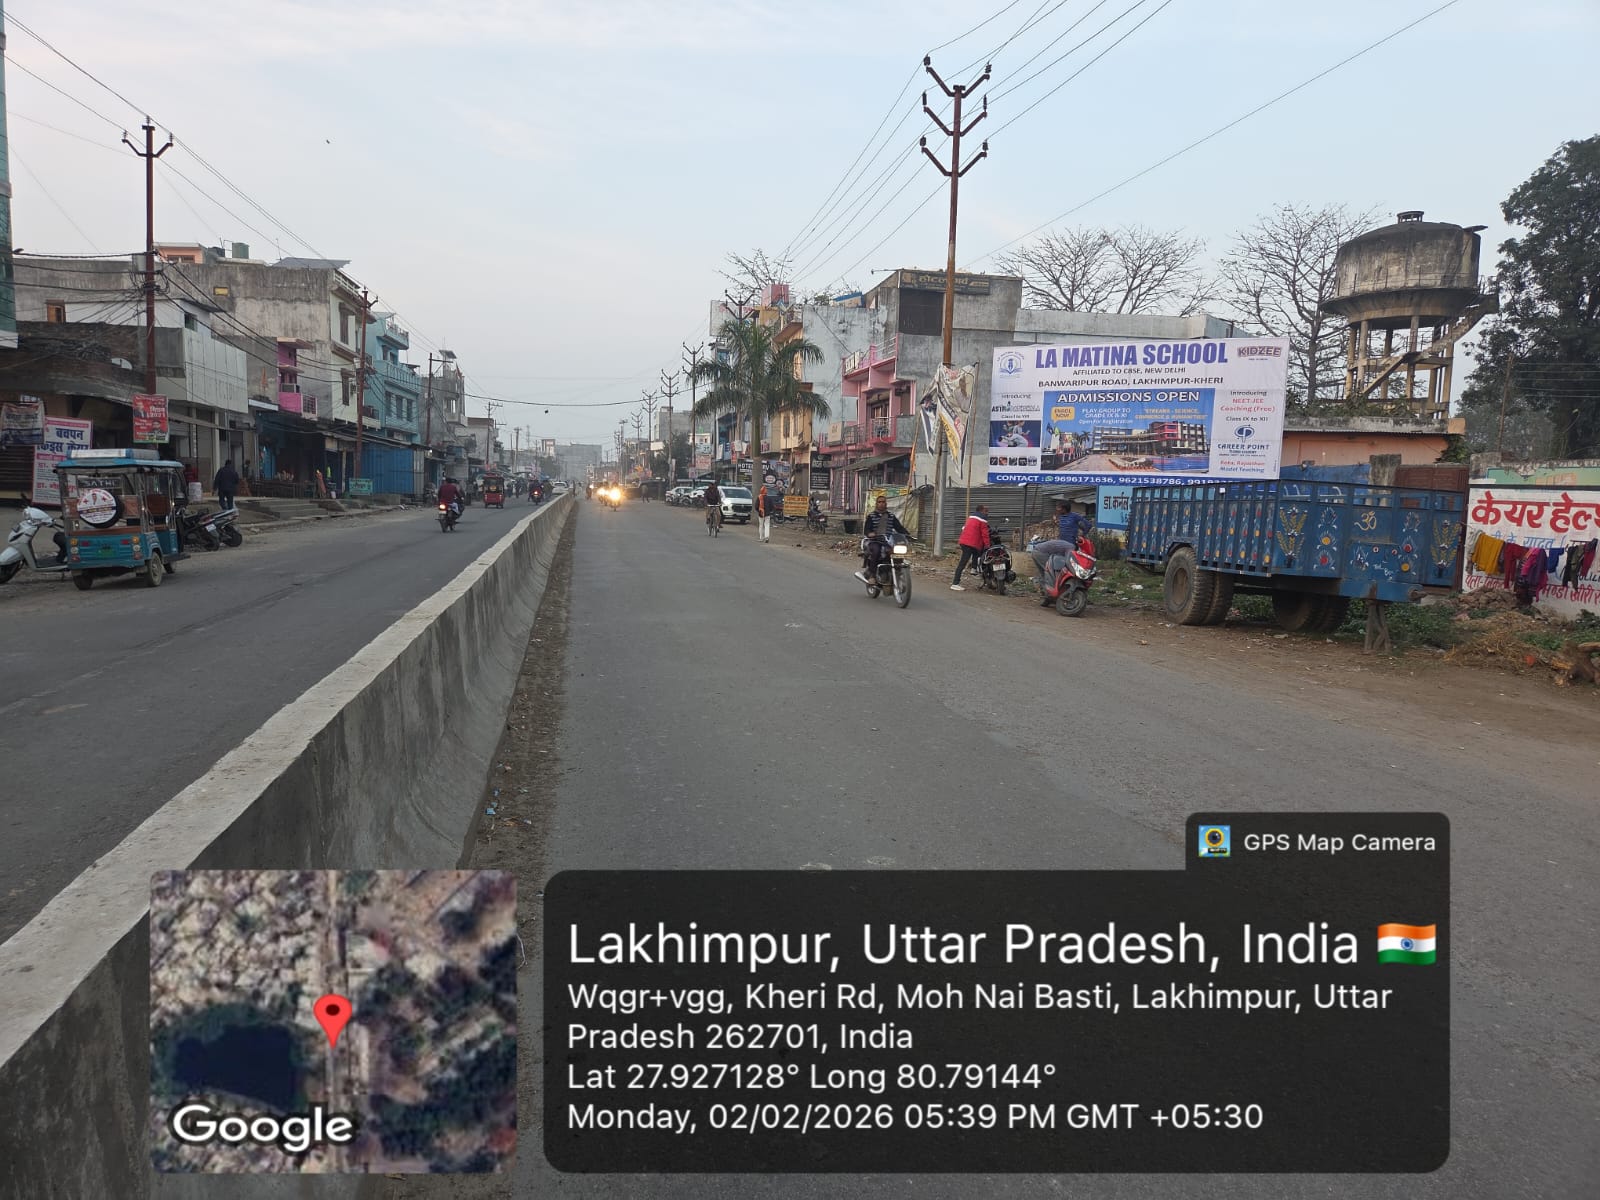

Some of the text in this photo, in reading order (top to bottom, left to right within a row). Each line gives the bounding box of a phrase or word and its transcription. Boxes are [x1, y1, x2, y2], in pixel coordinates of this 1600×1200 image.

[1035, 348, 1057, 369] LA
[1062, 345, 1138, 368] MATINA
[1142, 342, 1229, 366] SCHOOL
[1237, 345, 1282, 358] KIDZEE
[1123, 367, 1143, 375] CBSE,
[1038, 377, 1224, 388] BANWARIPUR ROAD, LAKHIMPUR-KHERI
[1057, 391, 1200, 403] ADMISSIONS OPEN
[996, 474, 1039, 482] CONTACT
[1471, 490, 1550, 528] केयर
